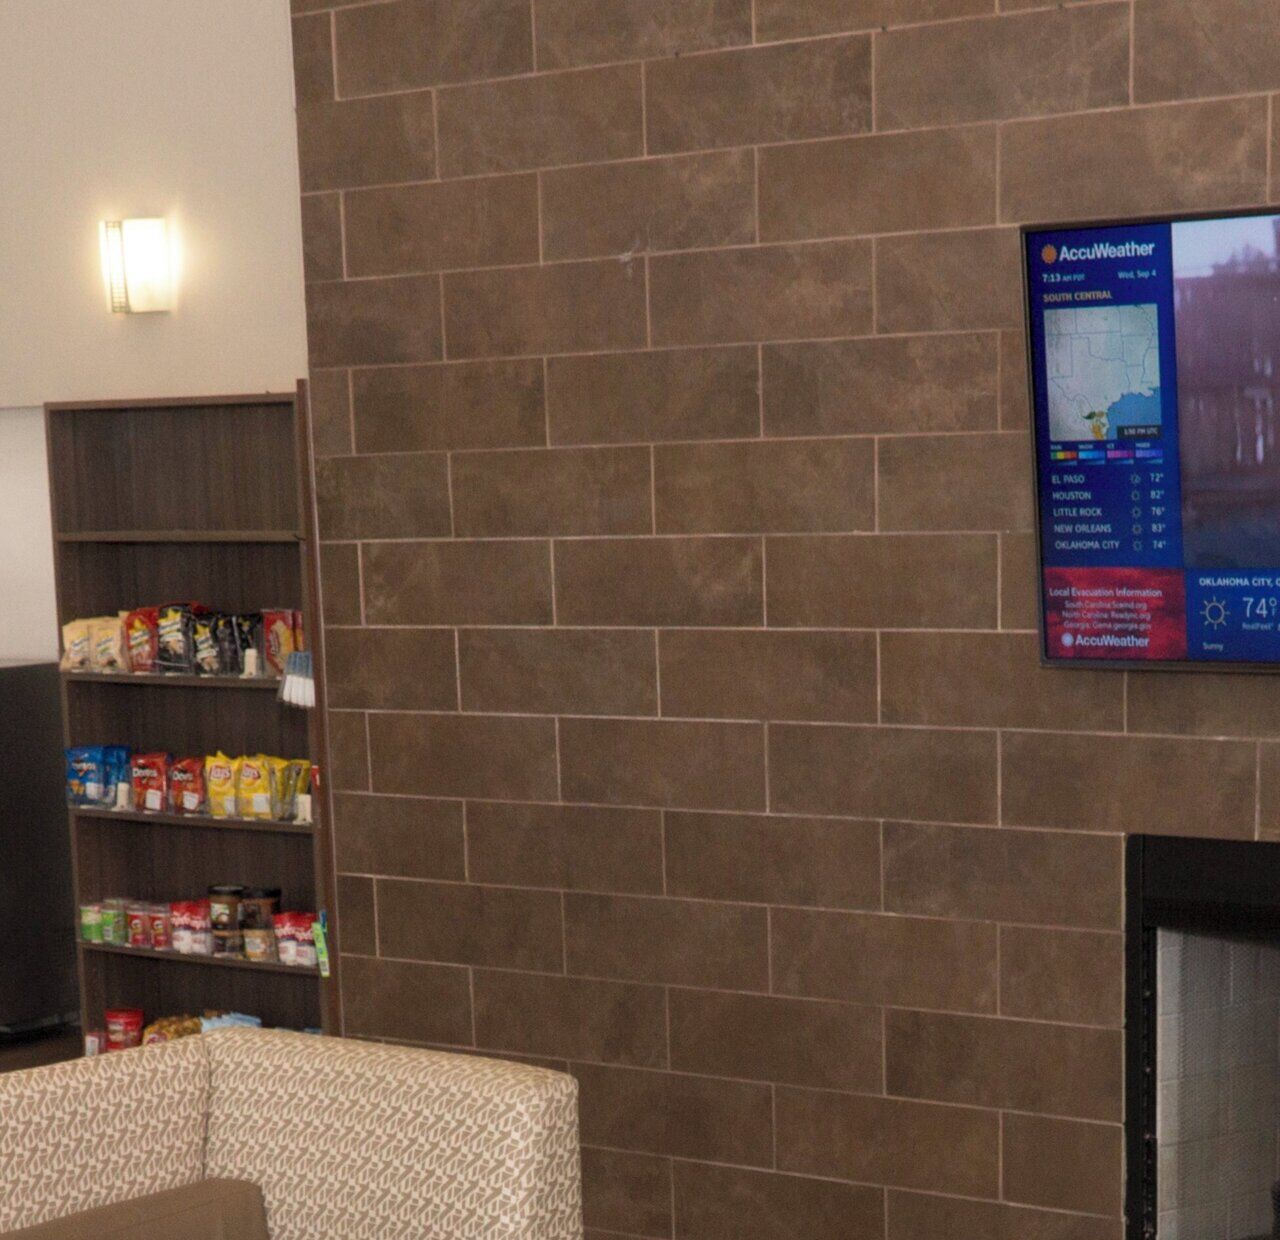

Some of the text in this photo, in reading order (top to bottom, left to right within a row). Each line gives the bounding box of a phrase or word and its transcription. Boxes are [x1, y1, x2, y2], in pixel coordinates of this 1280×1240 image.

[1059, 241, 1155, 261] AccuWeather
[1041, 273, 1061, 282] 7:13
[1137, 270, 1150, 279] Sep
[1043, 290, 1113, 302] SOUTH CENTRAL
[1052, 475, 1061, 484] EL
[1063, 474, 1085, 484] PASO
[1052, 491, 1091, 500] HOUSTON
[1053, 508, 1077, 517] LITTLE
[1079, 507, 1102, 516] ROCK
[1054, 524, 1073, 533] NEW
[1075, 524, 1112, 533] ORLEANS
[1055, 541, 1100, 549] OKLAHOMA
[1102, 541, 1120, 549] CITY
[1199, 577, 1249, 586] OKLAHOMA
[1252, 577, 1273, 587] CITY,
[1049, 587, 1163, 597] Local Evacuation Information
[1075, 634, 1150, 647] AccuWeather
